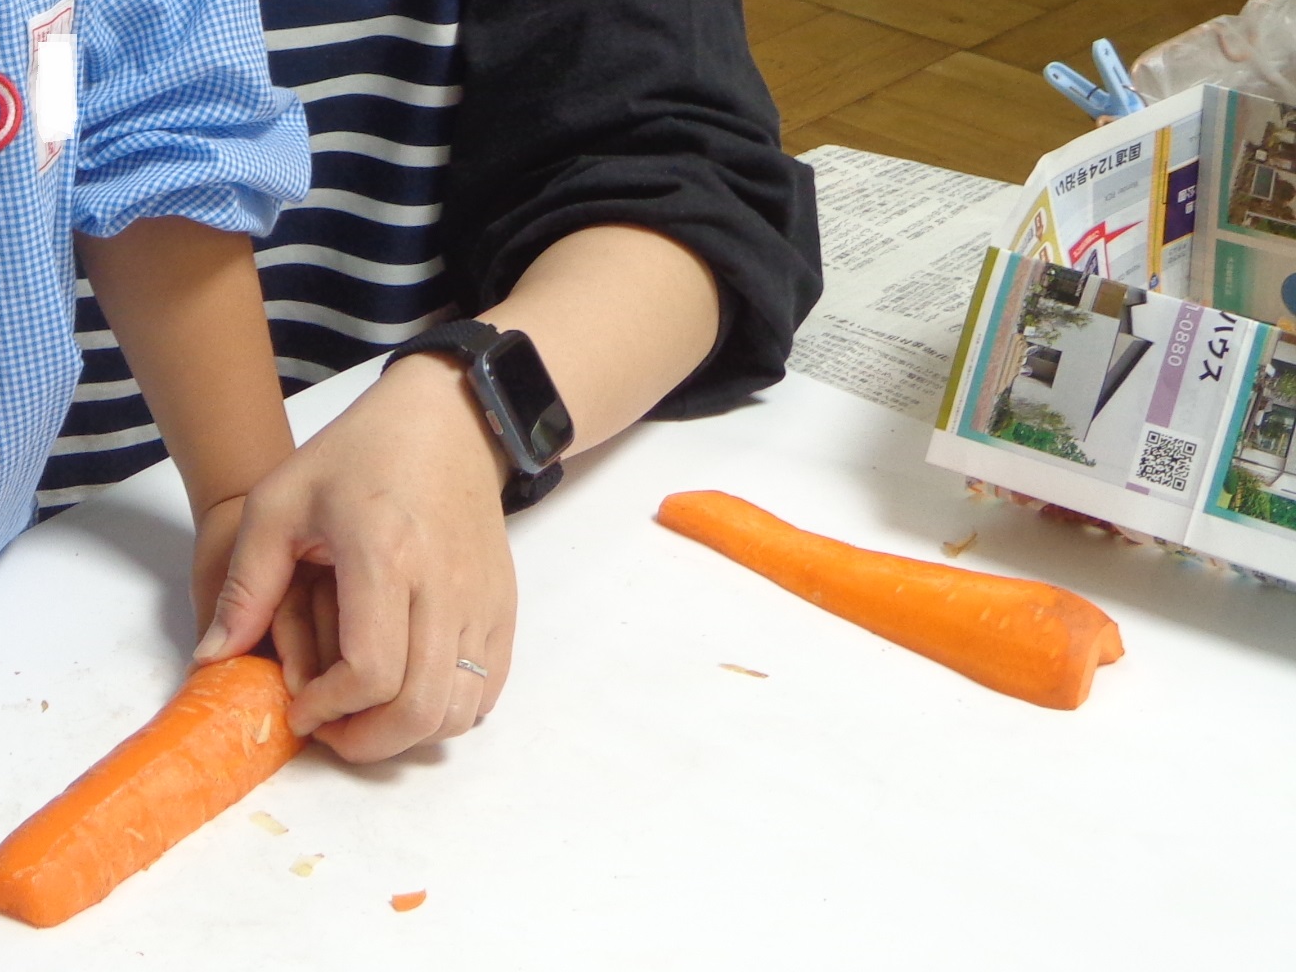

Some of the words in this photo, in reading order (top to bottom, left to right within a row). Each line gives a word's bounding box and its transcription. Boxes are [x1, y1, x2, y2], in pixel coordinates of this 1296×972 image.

[1055, 142, 1141, 196] 国道124号沿い
[1198, 310, 1237, 382] ハウス
